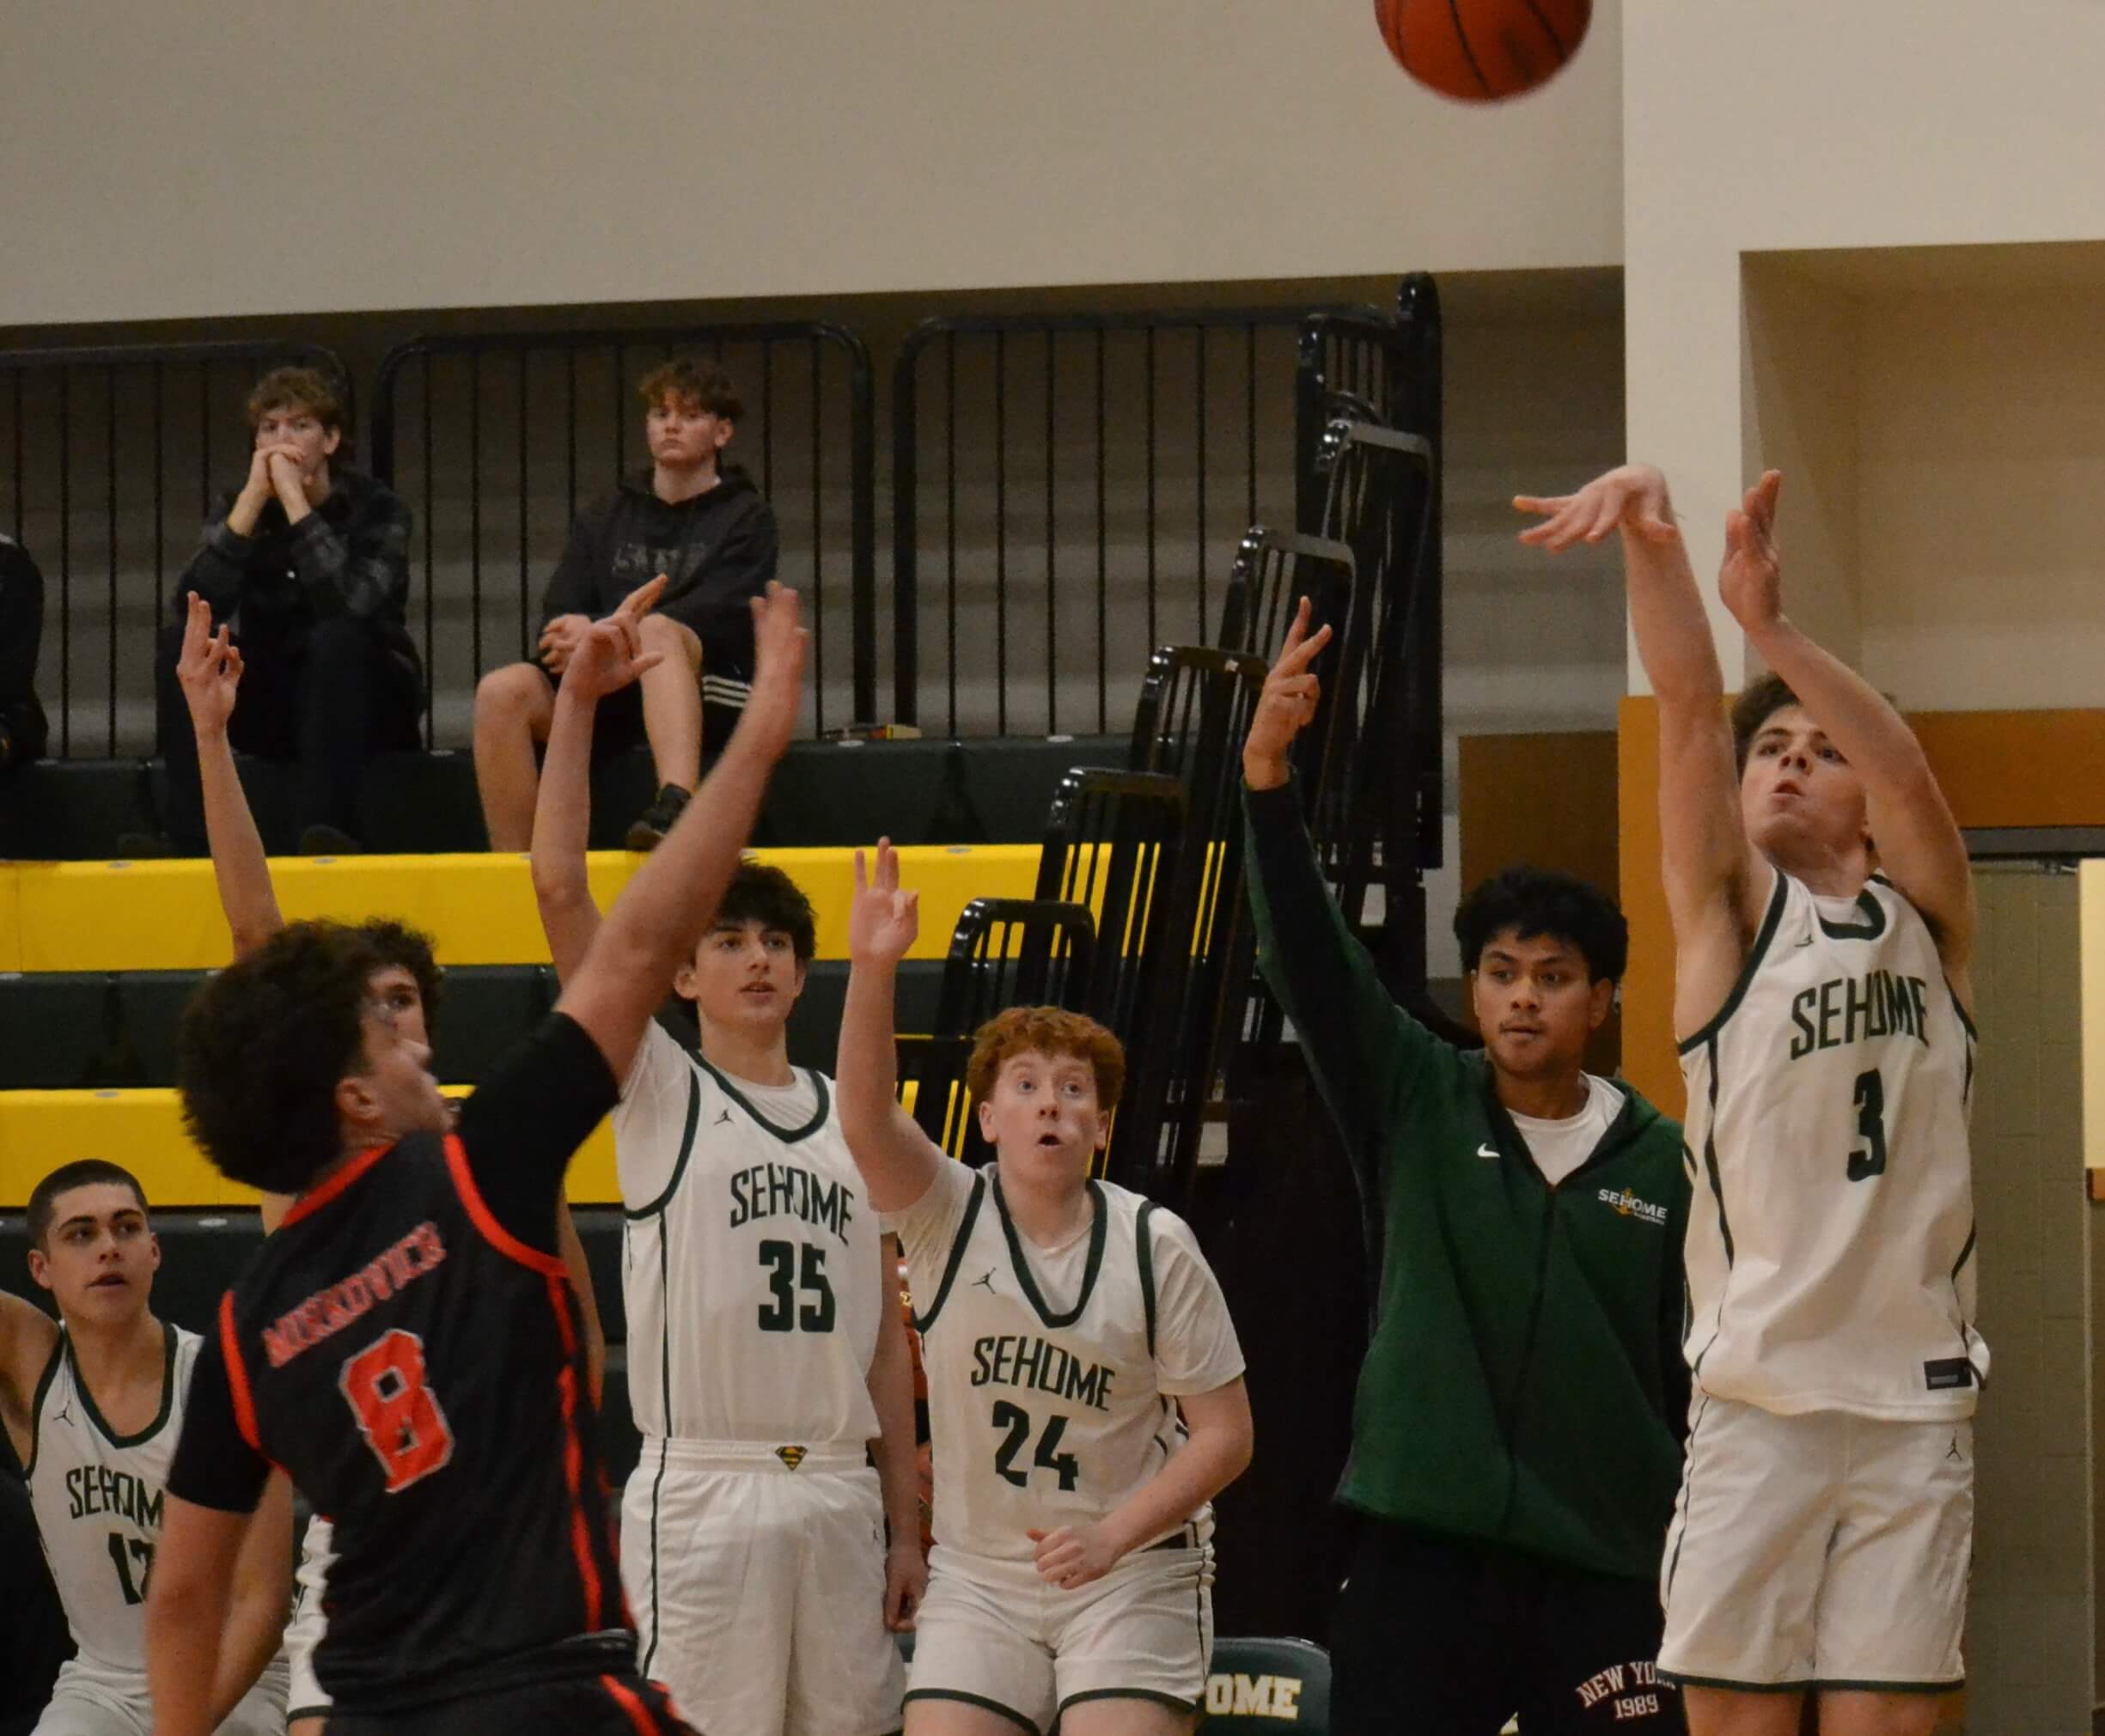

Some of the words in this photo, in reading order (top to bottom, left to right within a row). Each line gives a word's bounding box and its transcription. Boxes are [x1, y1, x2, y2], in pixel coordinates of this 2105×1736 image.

[1791, 970, 1929, 1060] SEHOME
[1847, 1069, 1886, 1182] 3
[730, 1162, 854, 1246] SEHOME
[1598, 1189, 1668, 1218] SEHOME
[759, 1240, 835, 1332] 35
[339, 1328, 455, 1493] 8
[971, 1337, 1115, 1411] SEHOME
[992, 1400, 1078, 1491] 24
[66, 1465, 165, 1531] SEHOM
[1205, 1673, 1302, 1721] OME
[1576, 1664, 1625, 1708] NEW
[1630, 1660, 1675, 1690] YO
[1614, 1693, 1659, 1719] 1989
